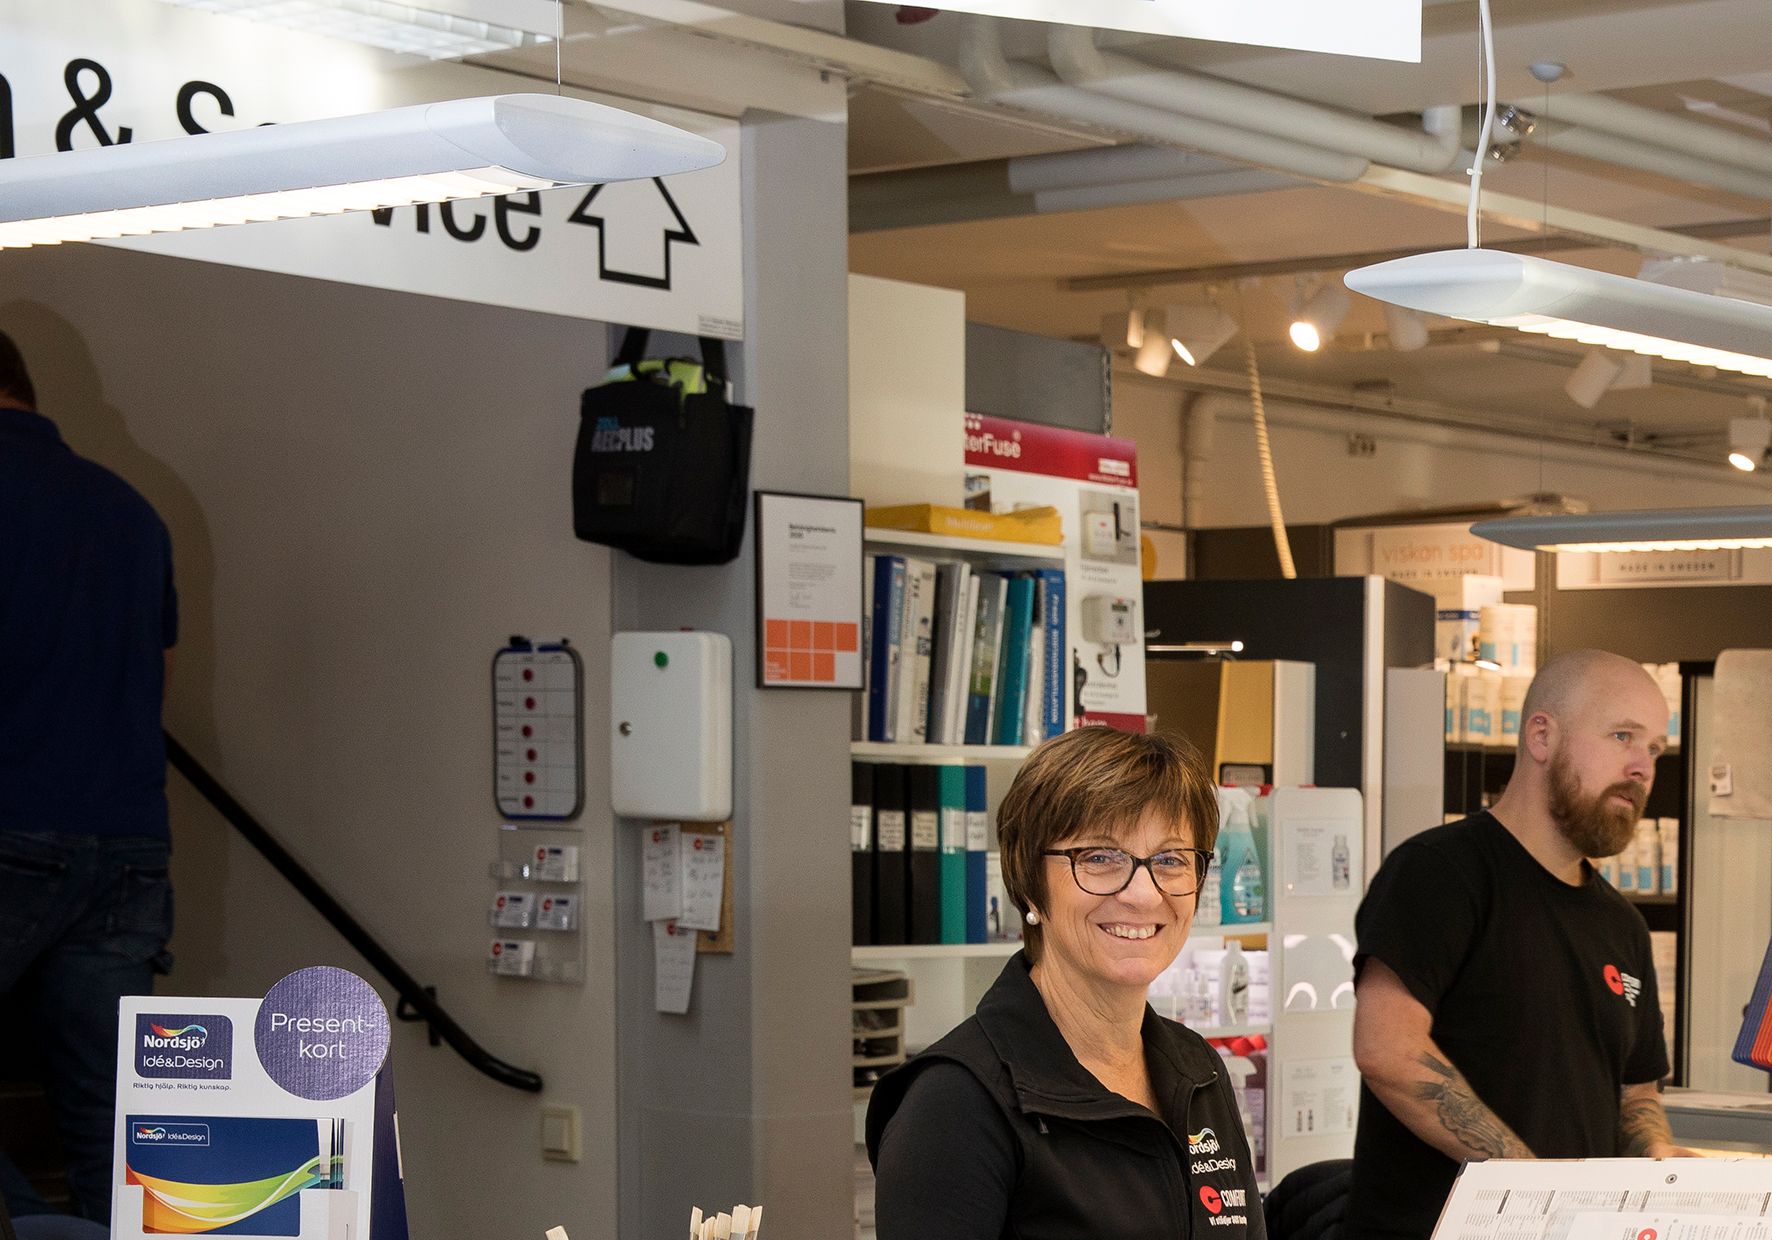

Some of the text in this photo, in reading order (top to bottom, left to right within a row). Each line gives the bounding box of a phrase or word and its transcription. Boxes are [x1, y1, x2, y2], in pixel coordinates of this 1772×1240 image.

[1449, 542, 1484, 564] spa
[271, 1013, 375, 1034] Present-
[143, 1032, 201, 1051] Nordsjö
[299, 1039, 347, 1059] kort
[143, 1054, 224, 1071] Idé&Design
[133, 1082, 232, 1092] Riktig hjälp. Riktig kunskap.
[136, 1130, 206, 1142] Nordsjö Idé&Design
[1188, 1139, 1219, 1155] ordsjö
